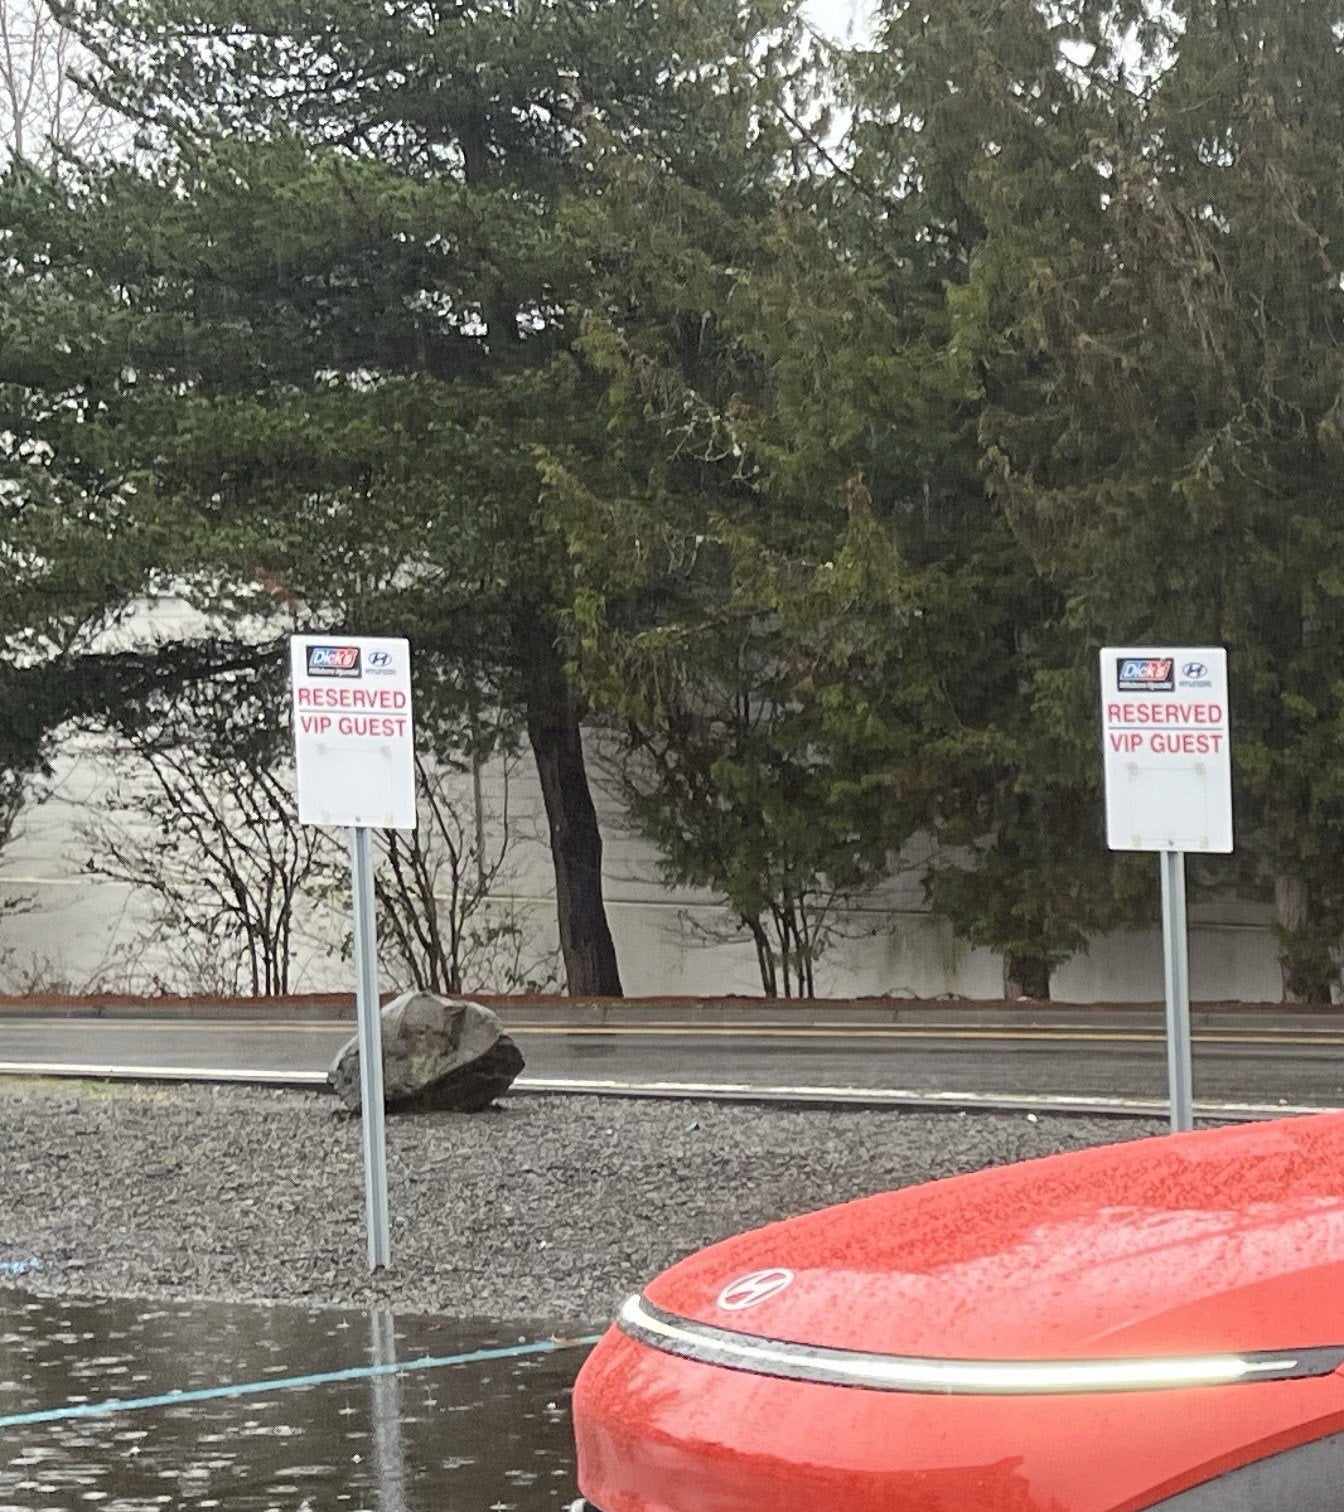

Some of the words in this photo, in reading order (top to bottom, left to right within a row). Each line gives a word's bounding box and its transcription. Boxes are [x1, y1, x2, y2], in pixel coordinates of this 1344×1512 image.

[298, 687, 406, 709] RESERVED
[1107, 703, 1222, 723] RESERVED
[300, 716, 332, 734] VIP
[338, 717, 407, 737] GUEST
[1110, 734, 1143, 753] VIP
[1150, 734, 1223, 754] GUEST
